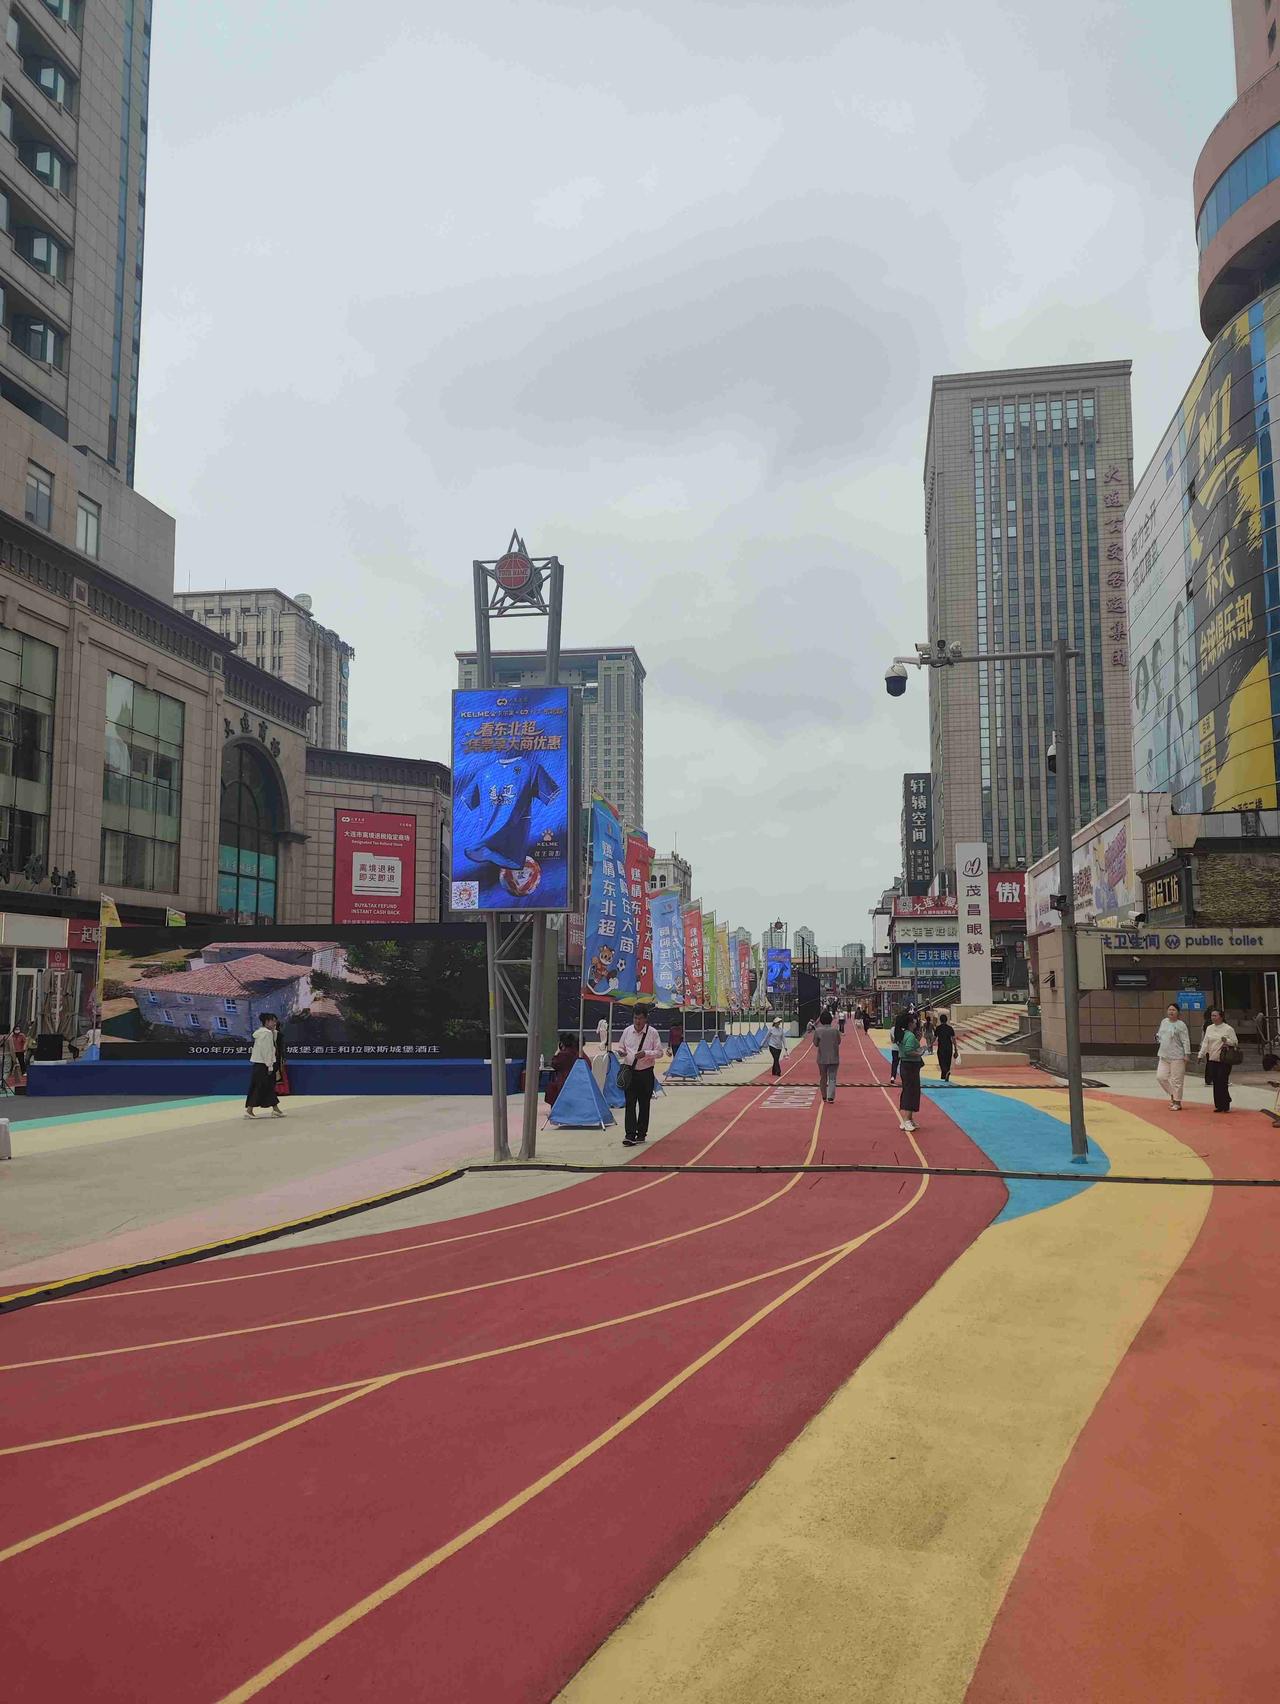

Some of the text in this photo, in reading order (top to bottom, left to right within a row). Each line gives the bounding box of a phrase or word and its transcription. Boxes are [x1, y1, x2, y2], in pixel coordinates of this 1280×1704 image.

[1104, 465, 1126, 667] 大连公交客运集团
[1200, 592, 1253, 676] 台球俱乐部
[479, 720, 539, 737] 看东北超
[910, 778, 928, 843] 轩辕空间
[359, 872, 396, 883] 即买即退
[360, 863, 396, 874] 离境退税
[598, 841, 617, 938] 燃情东北超
[966, 885, 984, 955] 茂昌眼镜
[1185, 935, 1224, 948] public
[1229, 934, 1264, 947] toilet
